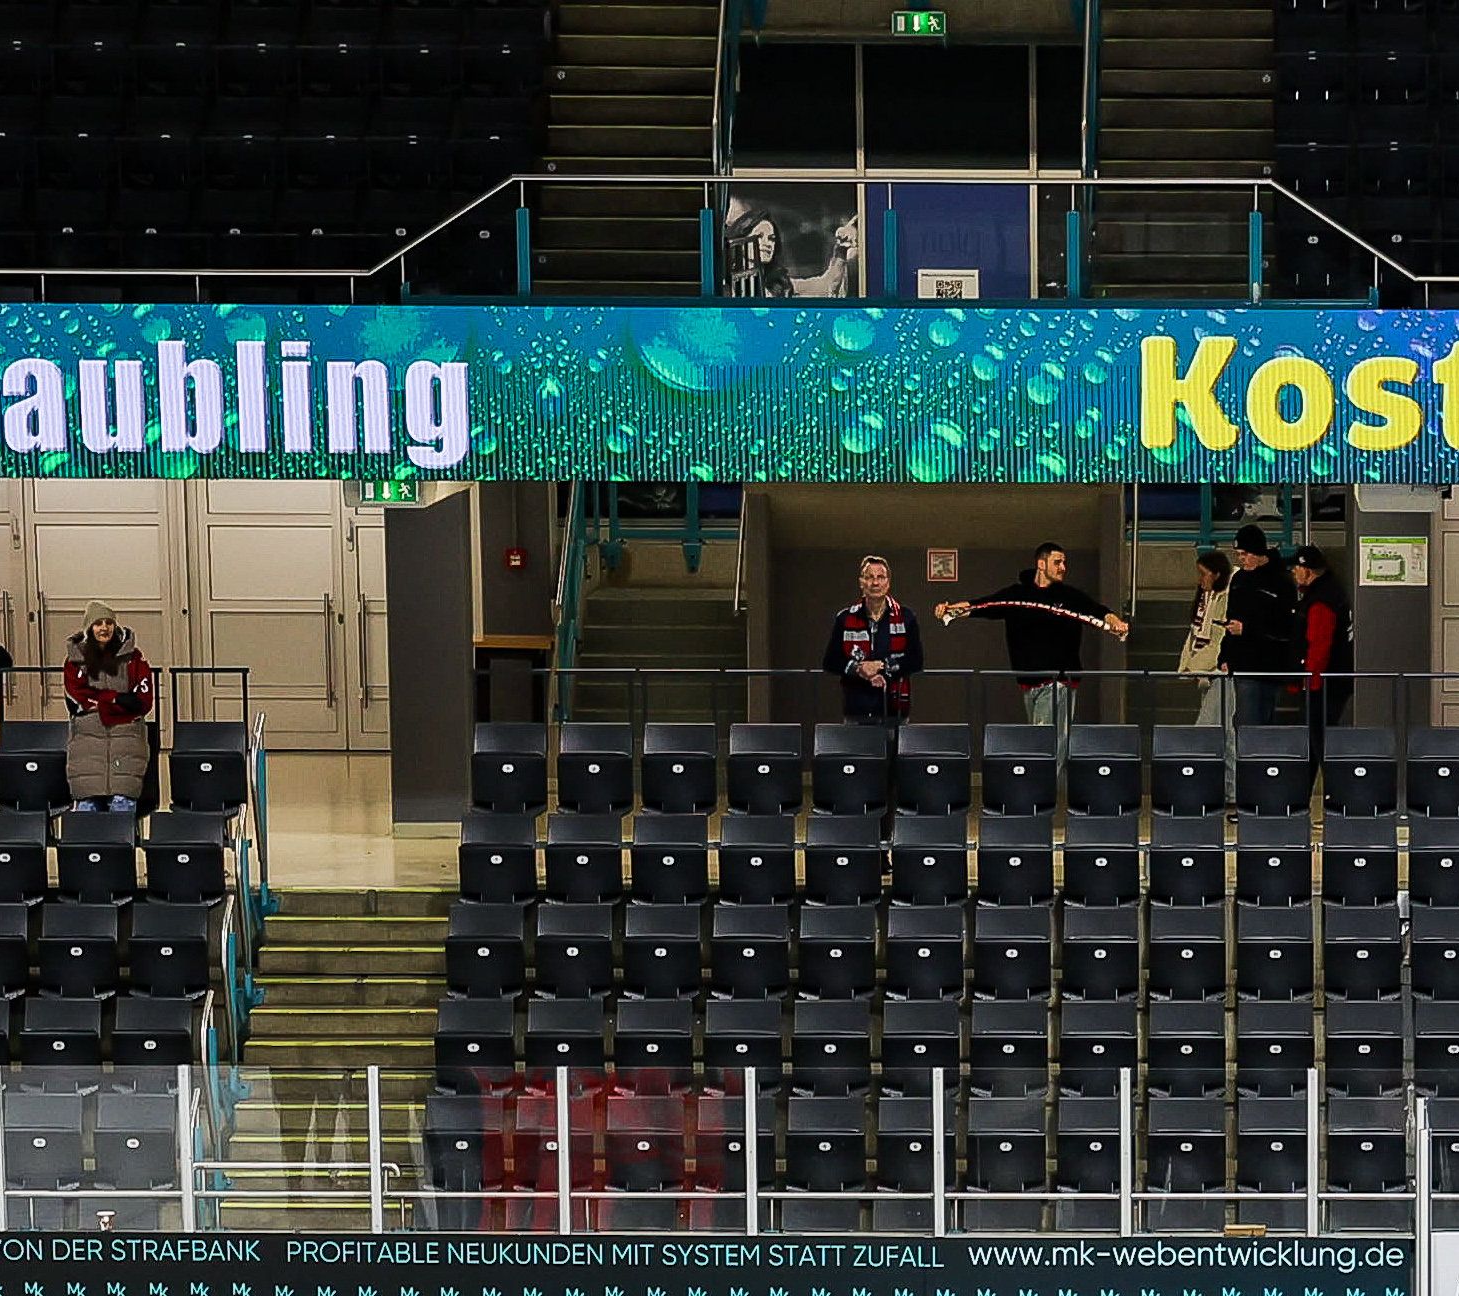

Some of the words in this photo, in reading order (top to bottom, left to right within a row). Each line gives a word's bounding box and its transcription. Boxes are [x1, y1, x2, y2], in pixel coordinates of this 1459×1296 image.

[52, 1240, 104, 1262] DER
[110, 1240, 261, 1263] STRAFBANK
[286, 1241, 440, 1264] PROFITABLE
[448, 1242, 604, 1265] NEUKUNDEN
[612, 1243, 655, 1265] MIT
[662, 1243, 761, 1267] SYSTEM
[768, 1244, 845, 1267] STATT
[852, 1245, 945, 1268] ZUFALL
[967, 1240, 1405, 1274] www.mk-webentwicklung.de
